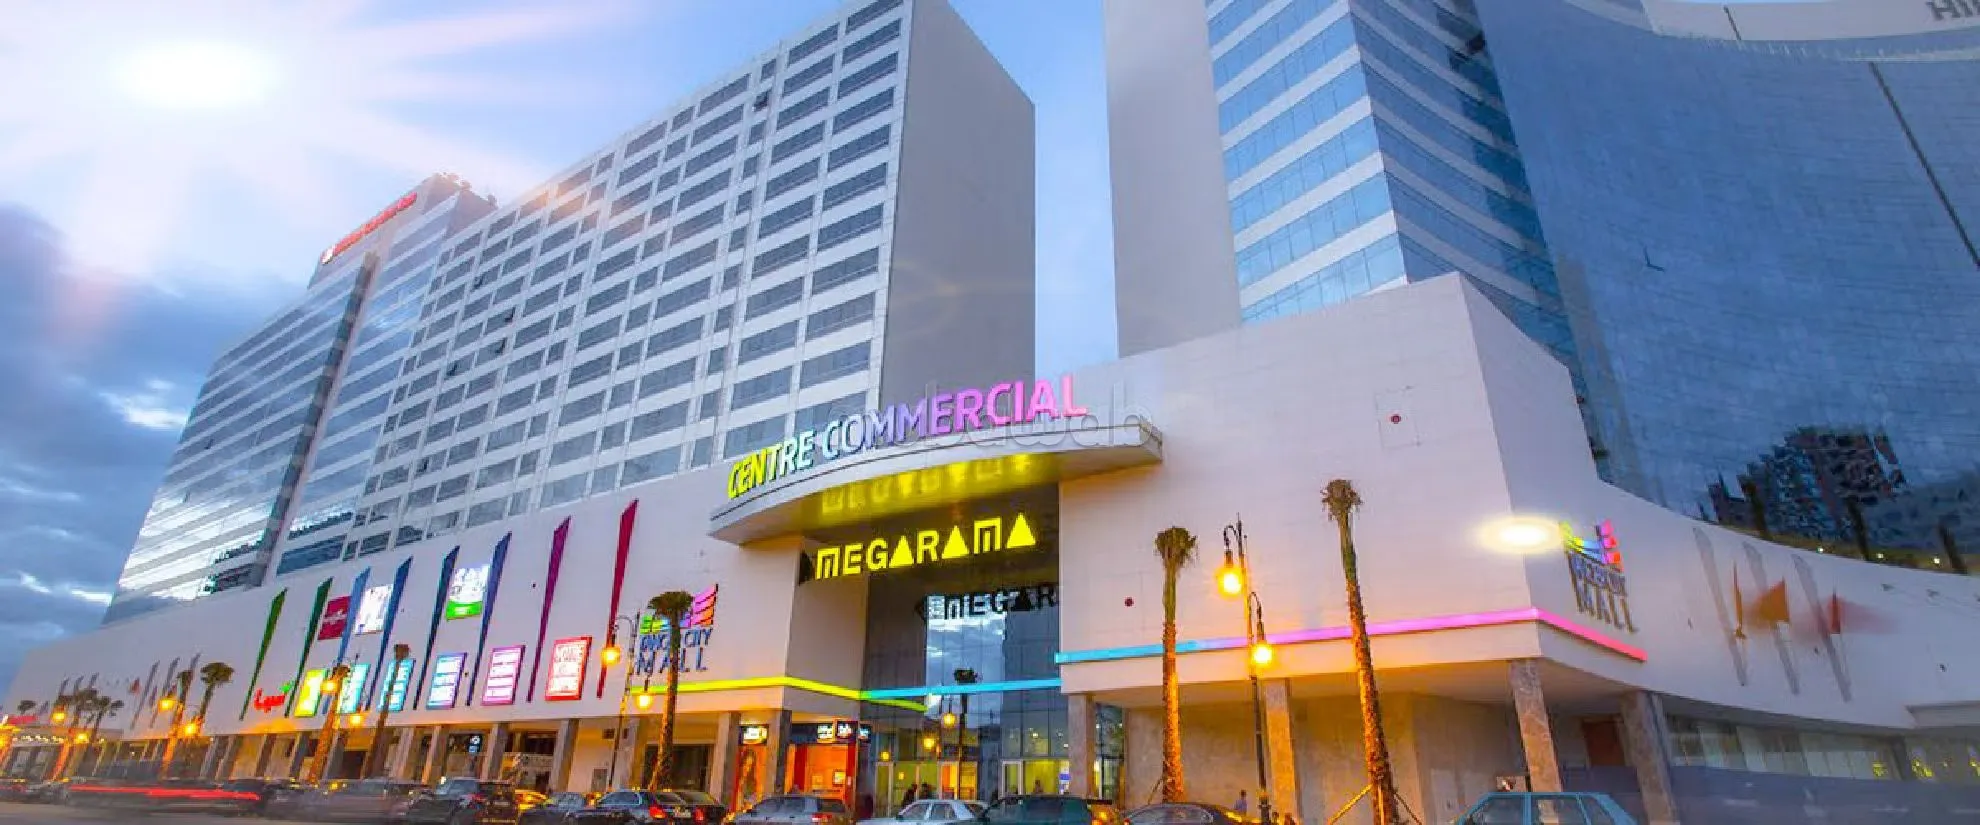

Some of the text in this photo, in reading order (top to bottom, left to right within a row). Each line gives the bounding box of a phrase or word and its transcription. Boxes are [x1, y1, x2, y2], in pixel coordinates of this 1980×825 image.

[728, 429, 816, 499] CENTRE
[822, 374, 1088, 461] COMMERCIAL
[815, 512, 1037, 580] MEGARAMA
